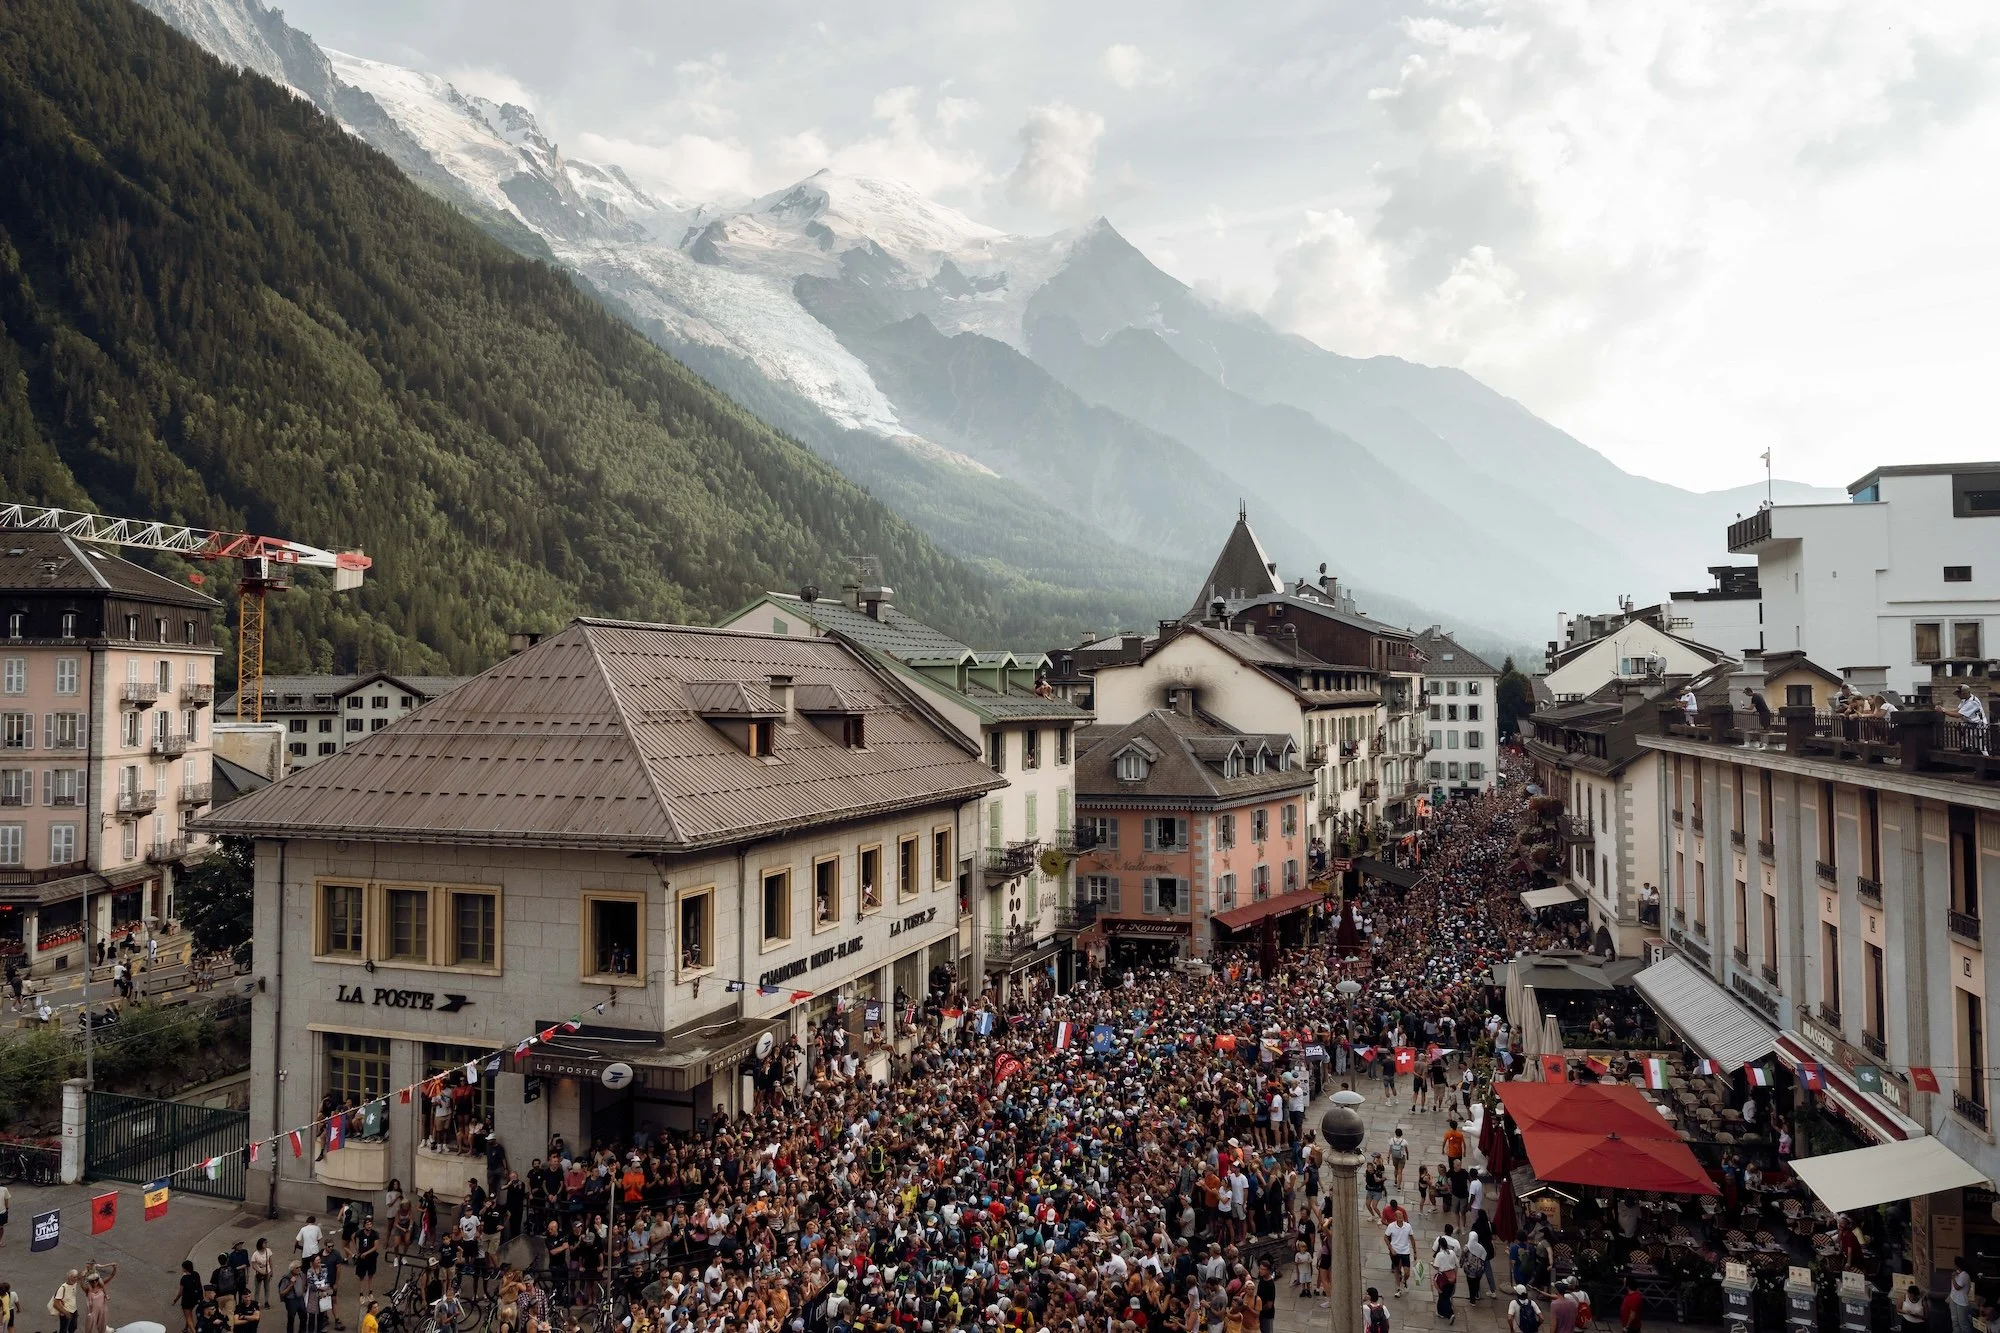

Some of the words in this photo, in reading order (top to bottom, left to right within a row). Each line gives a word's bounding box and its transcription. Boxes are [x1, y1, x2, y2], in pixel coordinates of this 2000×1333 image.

[759, 957, 808, 989] CHAMONIX
[336, 984, 365, 1004] LA
[372, 988, 435, 1011] POSTE
[1802, 1020, 1835, 1057] BRASSERIE
[536, 1063, 551, 1072] LA
[558, 1065, 599, 1077] POSTE
[714, 1061, 724, 1070] LA
[727, 1048, 750, 1064] POSTE
[35, 1222, 59, 1237] UTMB
